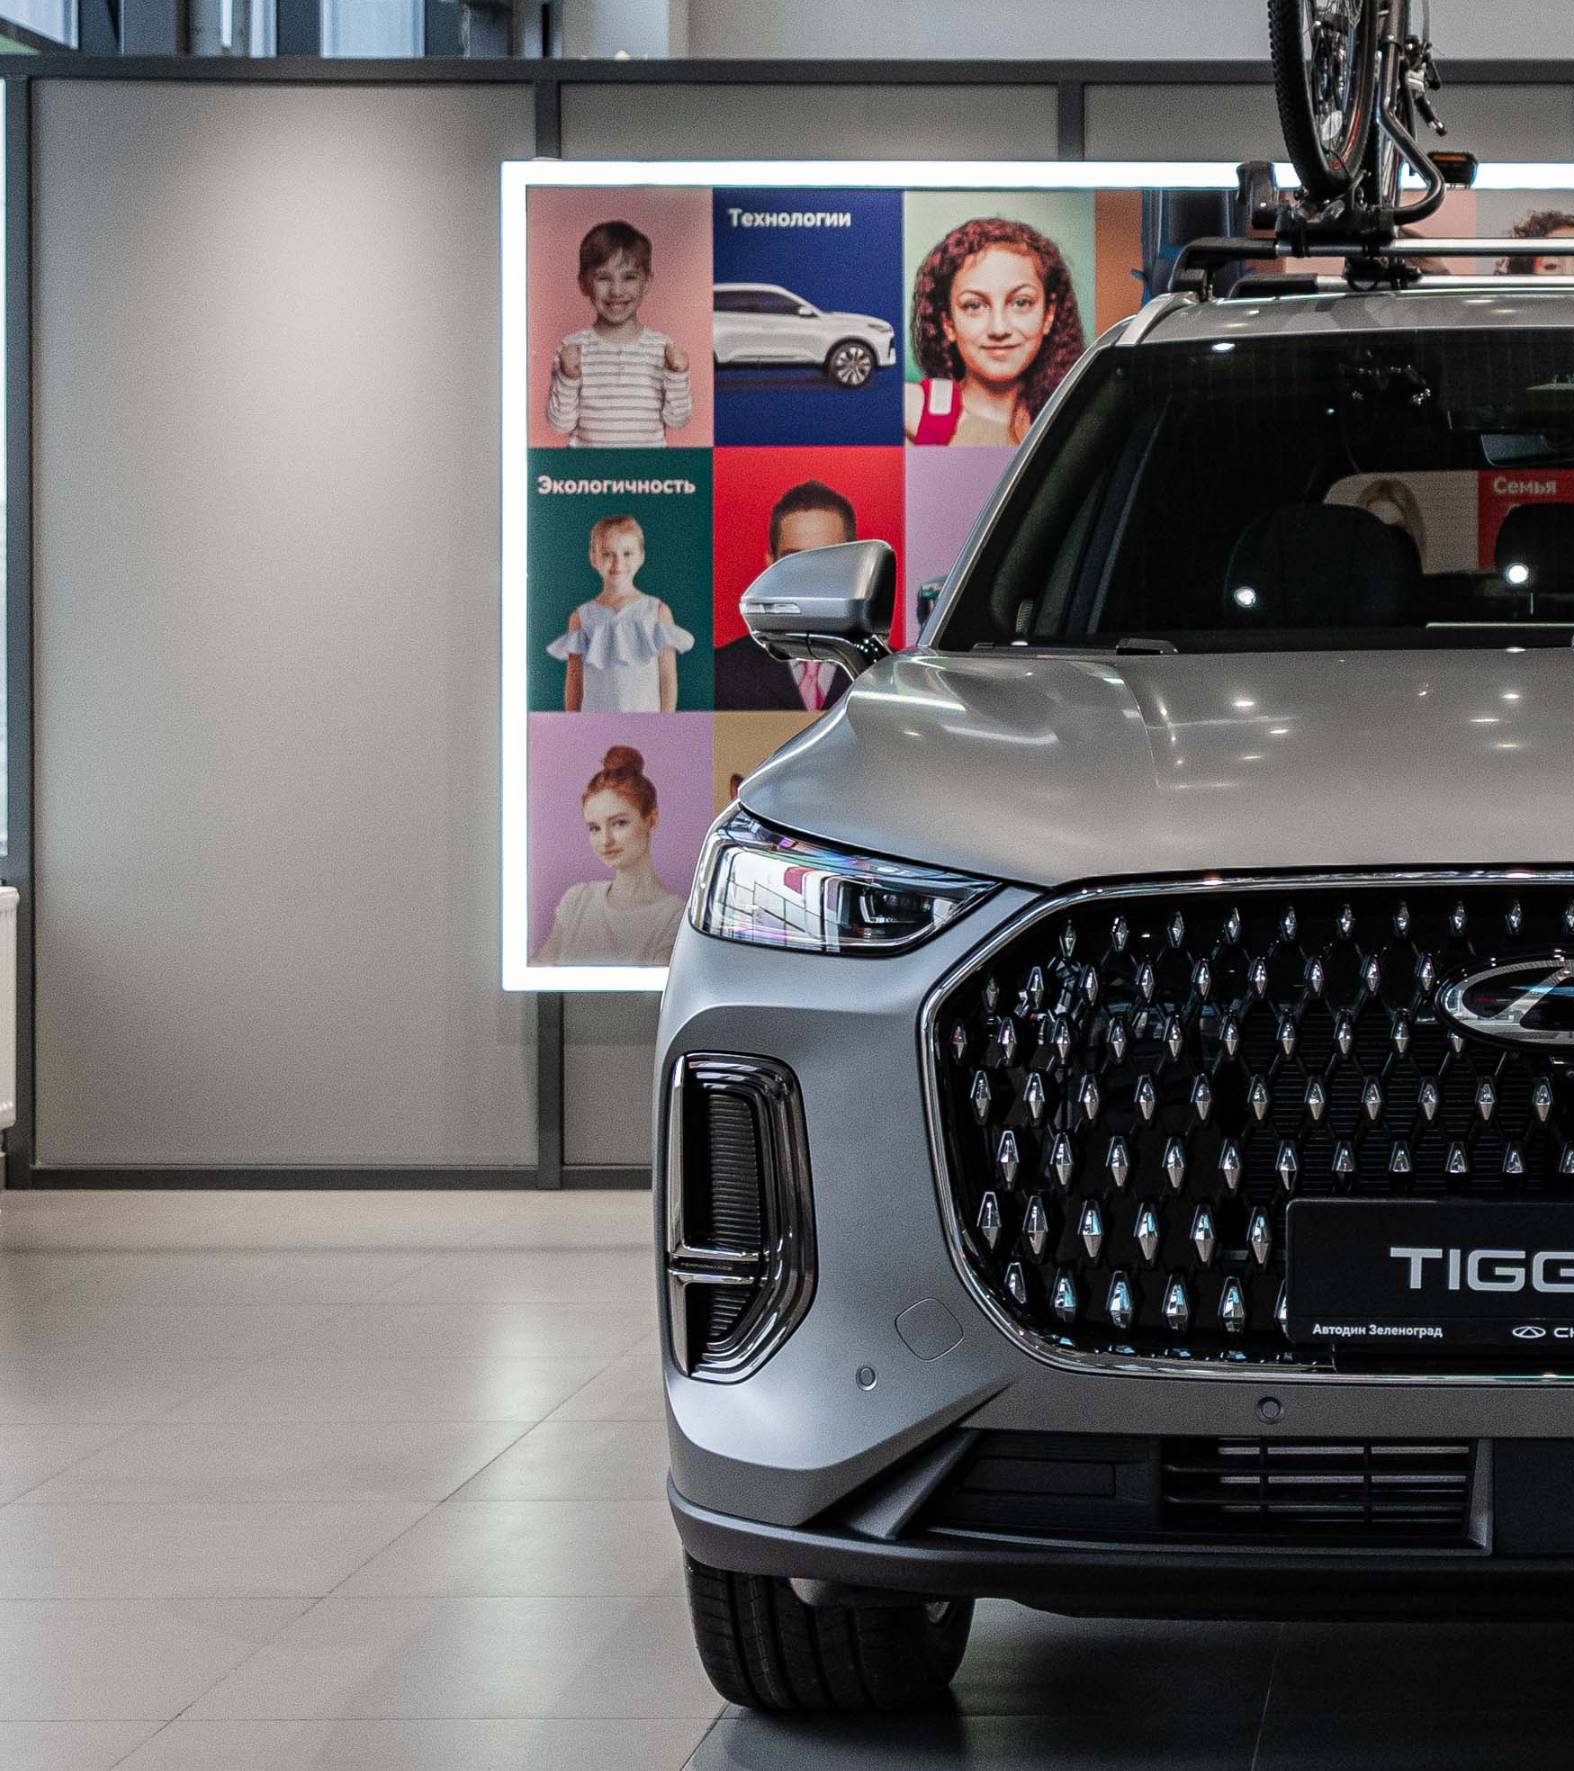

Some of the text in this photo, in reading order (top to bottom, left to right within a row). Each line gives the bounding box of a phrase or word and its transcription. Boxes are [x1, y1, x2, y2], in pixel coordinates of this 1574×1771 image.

[728, 208, 852, 227] Технологии
[538, 475, 696, 494] Экологичность
[1493, 476, 1557, 494] Семья
[1312, 1323, 1443, 1339] Автодин Зеленоград
